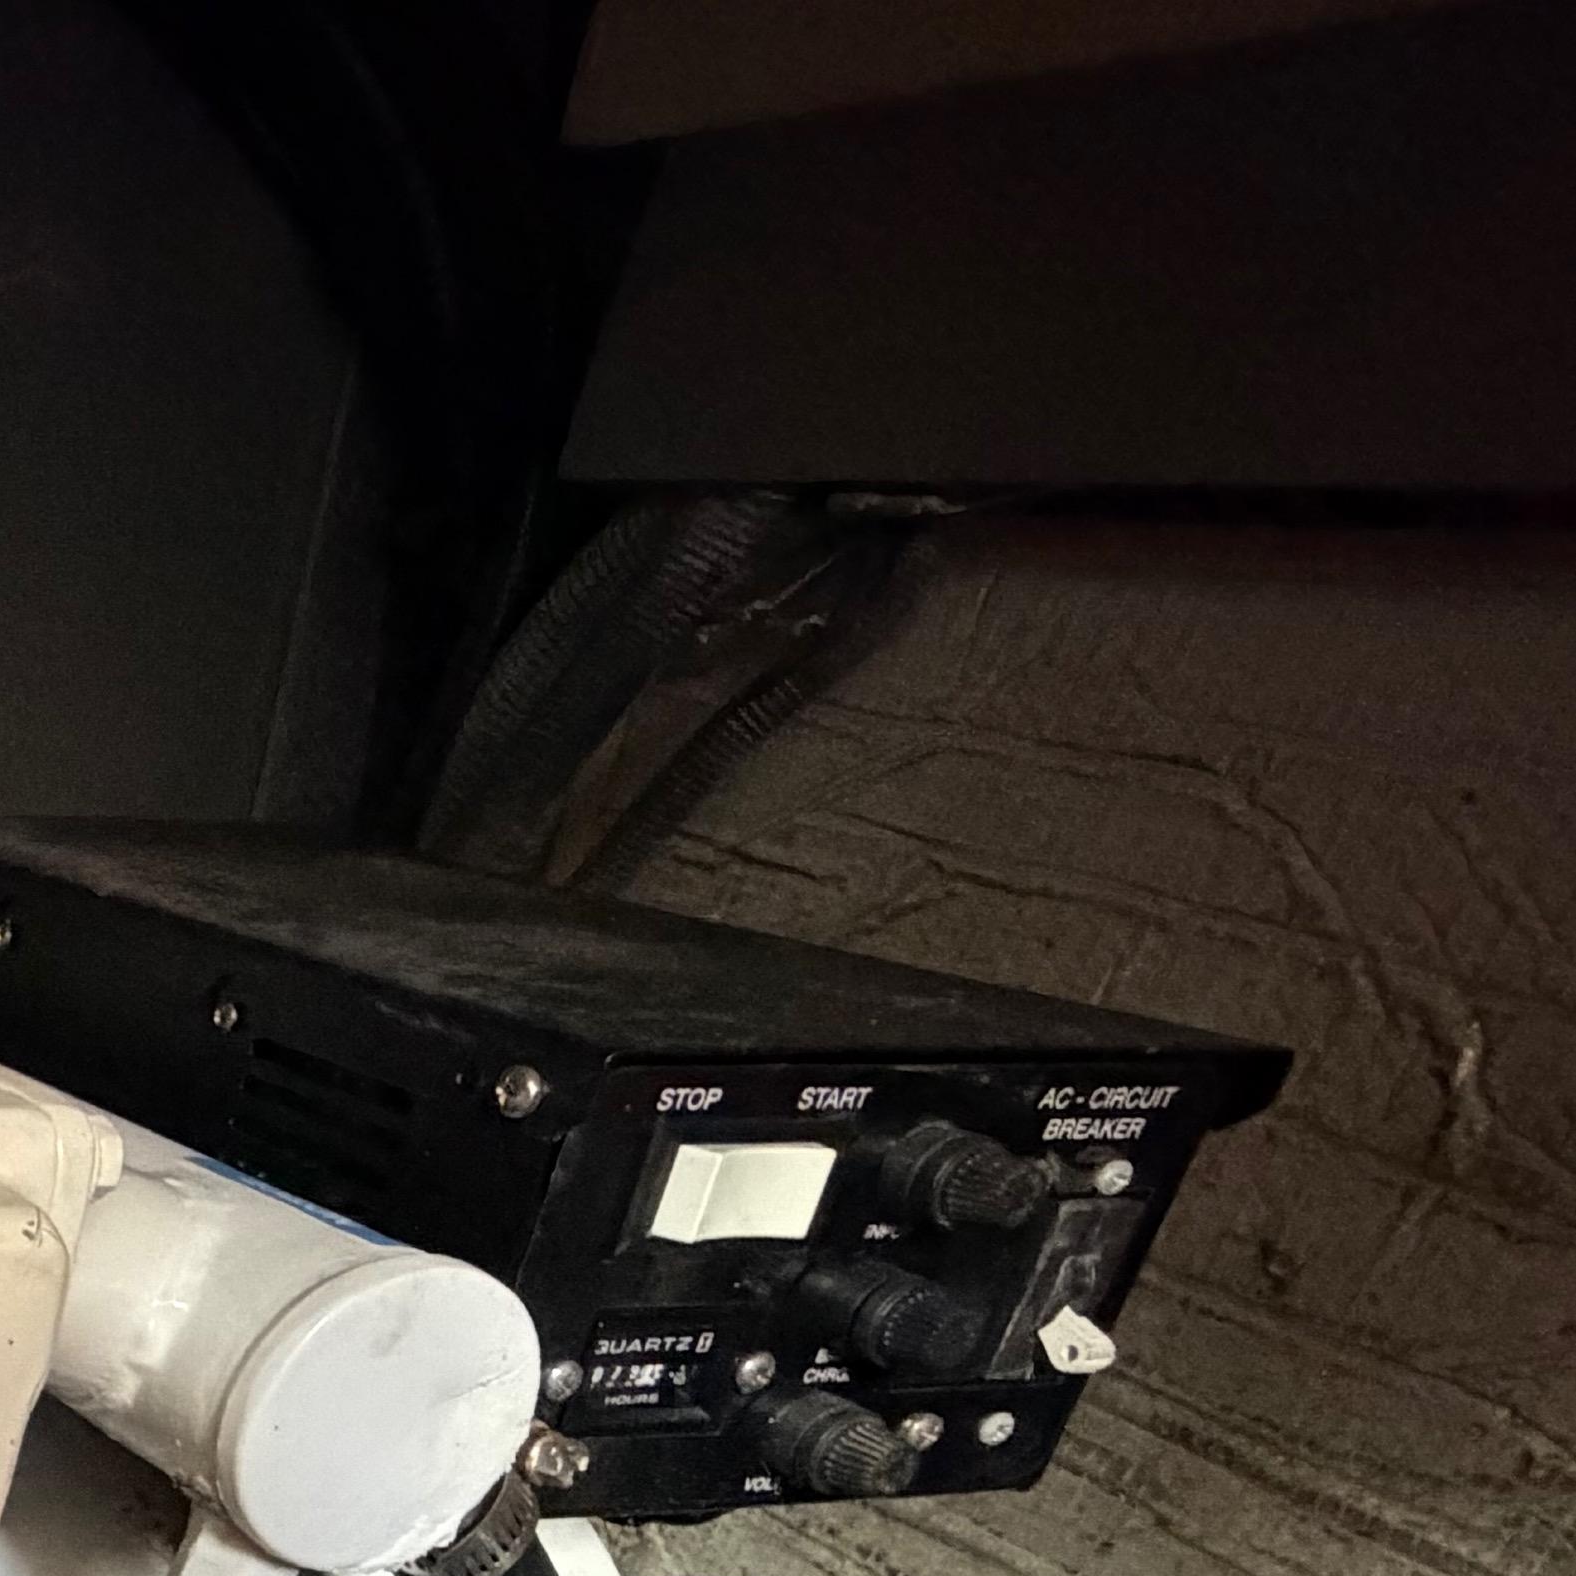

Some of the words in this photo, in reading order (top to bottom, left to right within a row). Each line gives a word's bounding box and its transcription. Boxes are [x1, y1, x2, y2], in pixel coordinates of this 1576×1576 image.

[656, 1087, 722, 1112] STOP
[797, 1086, 872, 1111] START
[1042, 1117, 1147, 1142] BREAKER
